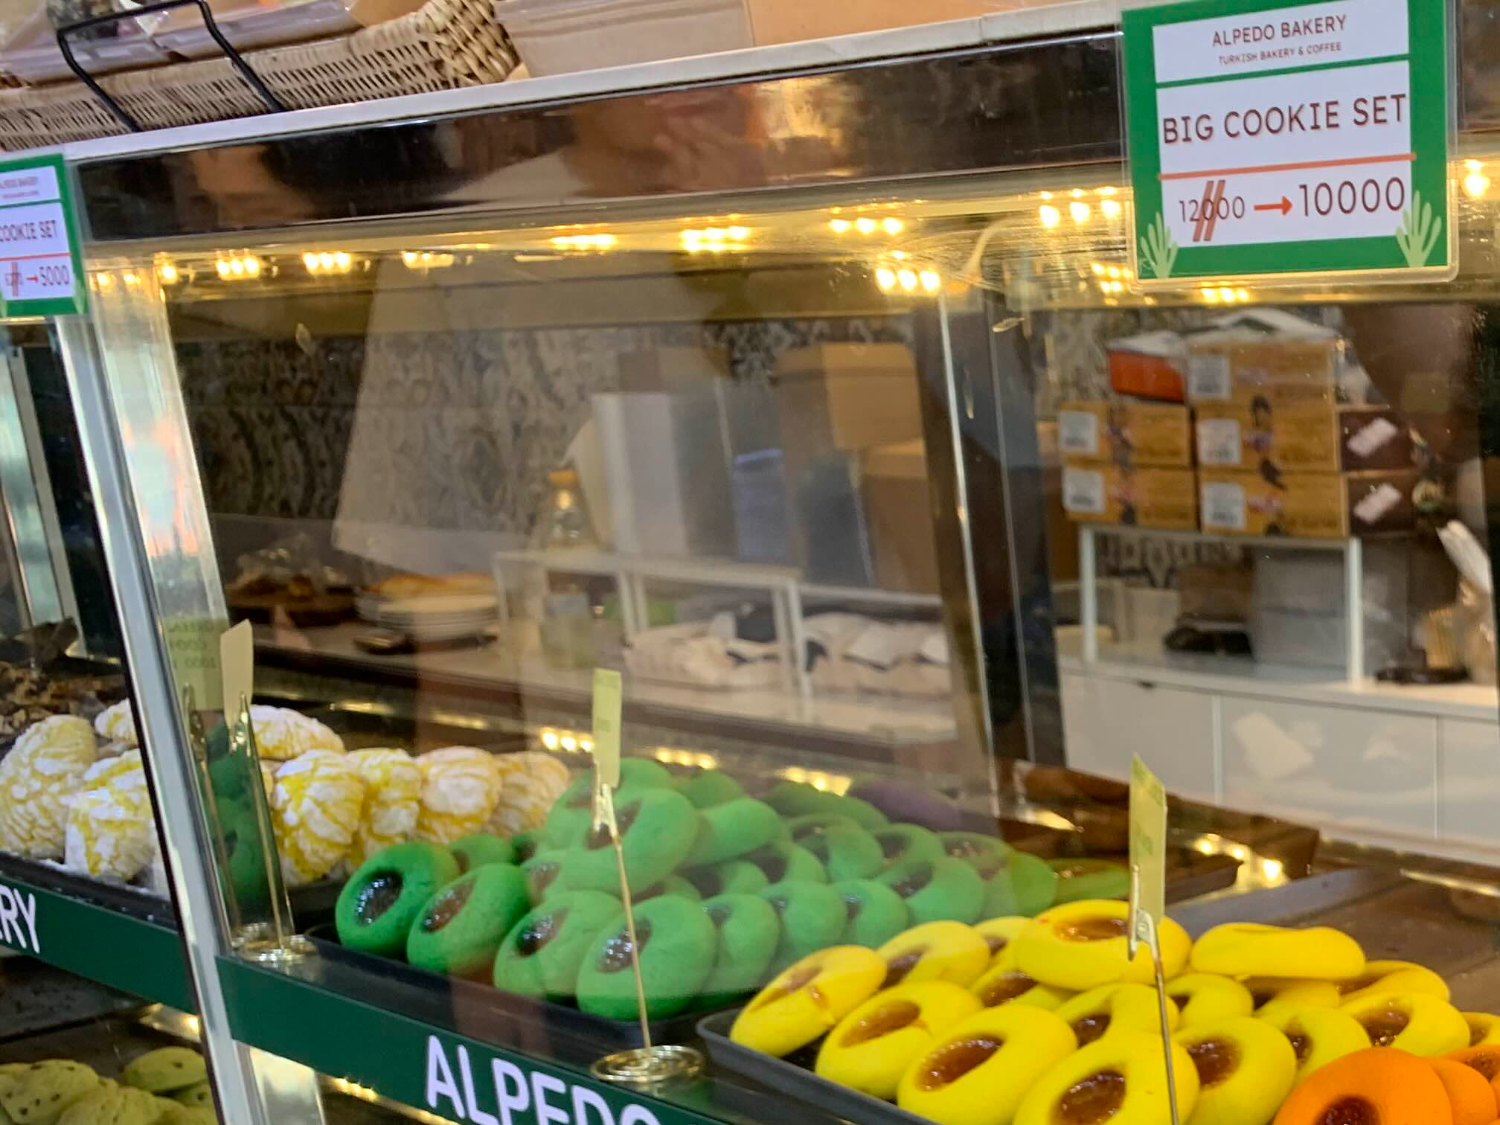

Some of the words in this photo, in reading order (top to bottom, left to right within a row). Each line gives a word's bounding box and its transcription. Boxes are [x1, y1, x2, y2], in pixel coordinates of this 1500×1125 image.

[1212, 24, 1275, 47] ALPEDO
[1281, 14, 1347, 38] BAKERY
[1218, 51, 1258, 65] TURKISH
[1260, 47, 1295, 60] BAKERY
[1297, 46, 1304, 56] &
[1307, 42, 1342, 55] COFFEE
[1162, 113, 1213, 144] BIG
[1223, 100, 1340, 138] COOKIE
[1352, 94, 1407, 126] SET
[1179, 196, 1245, 223] 12000
[1298, 176, 1405, 217] 10000
[0, 885, 40, 953] RY
